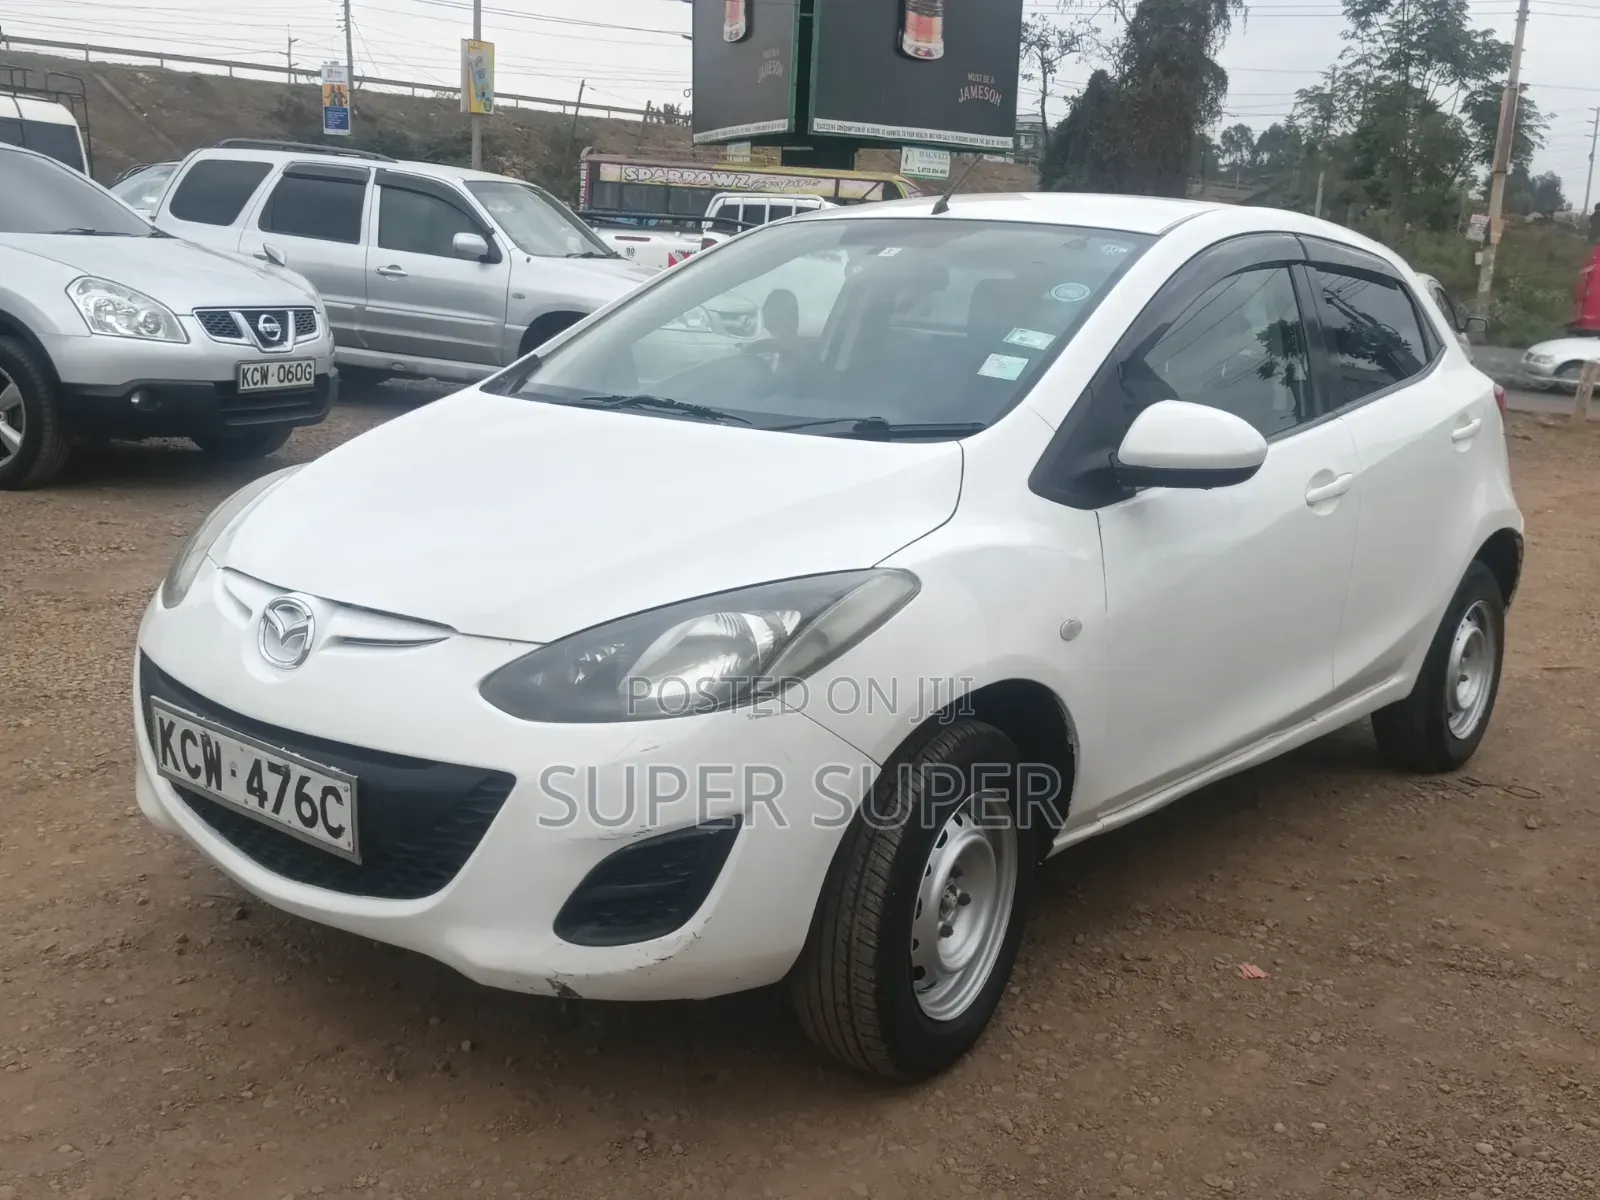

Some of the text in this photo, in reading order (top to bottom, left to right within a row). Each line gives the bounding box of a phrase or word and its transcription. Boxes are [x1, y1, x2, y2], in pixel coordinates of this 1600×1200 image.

[967, 72, 995, 84] MUST BE A
[958, 85, 1002, 107] JAMESON
[919, 150, 949, 161] MAGNATE
[624, 167, 821, 191] SPARROWZ Empire
[242, 363, 312, 388] KCW 060G
[158, 717, 346, 840] KCW 476C
